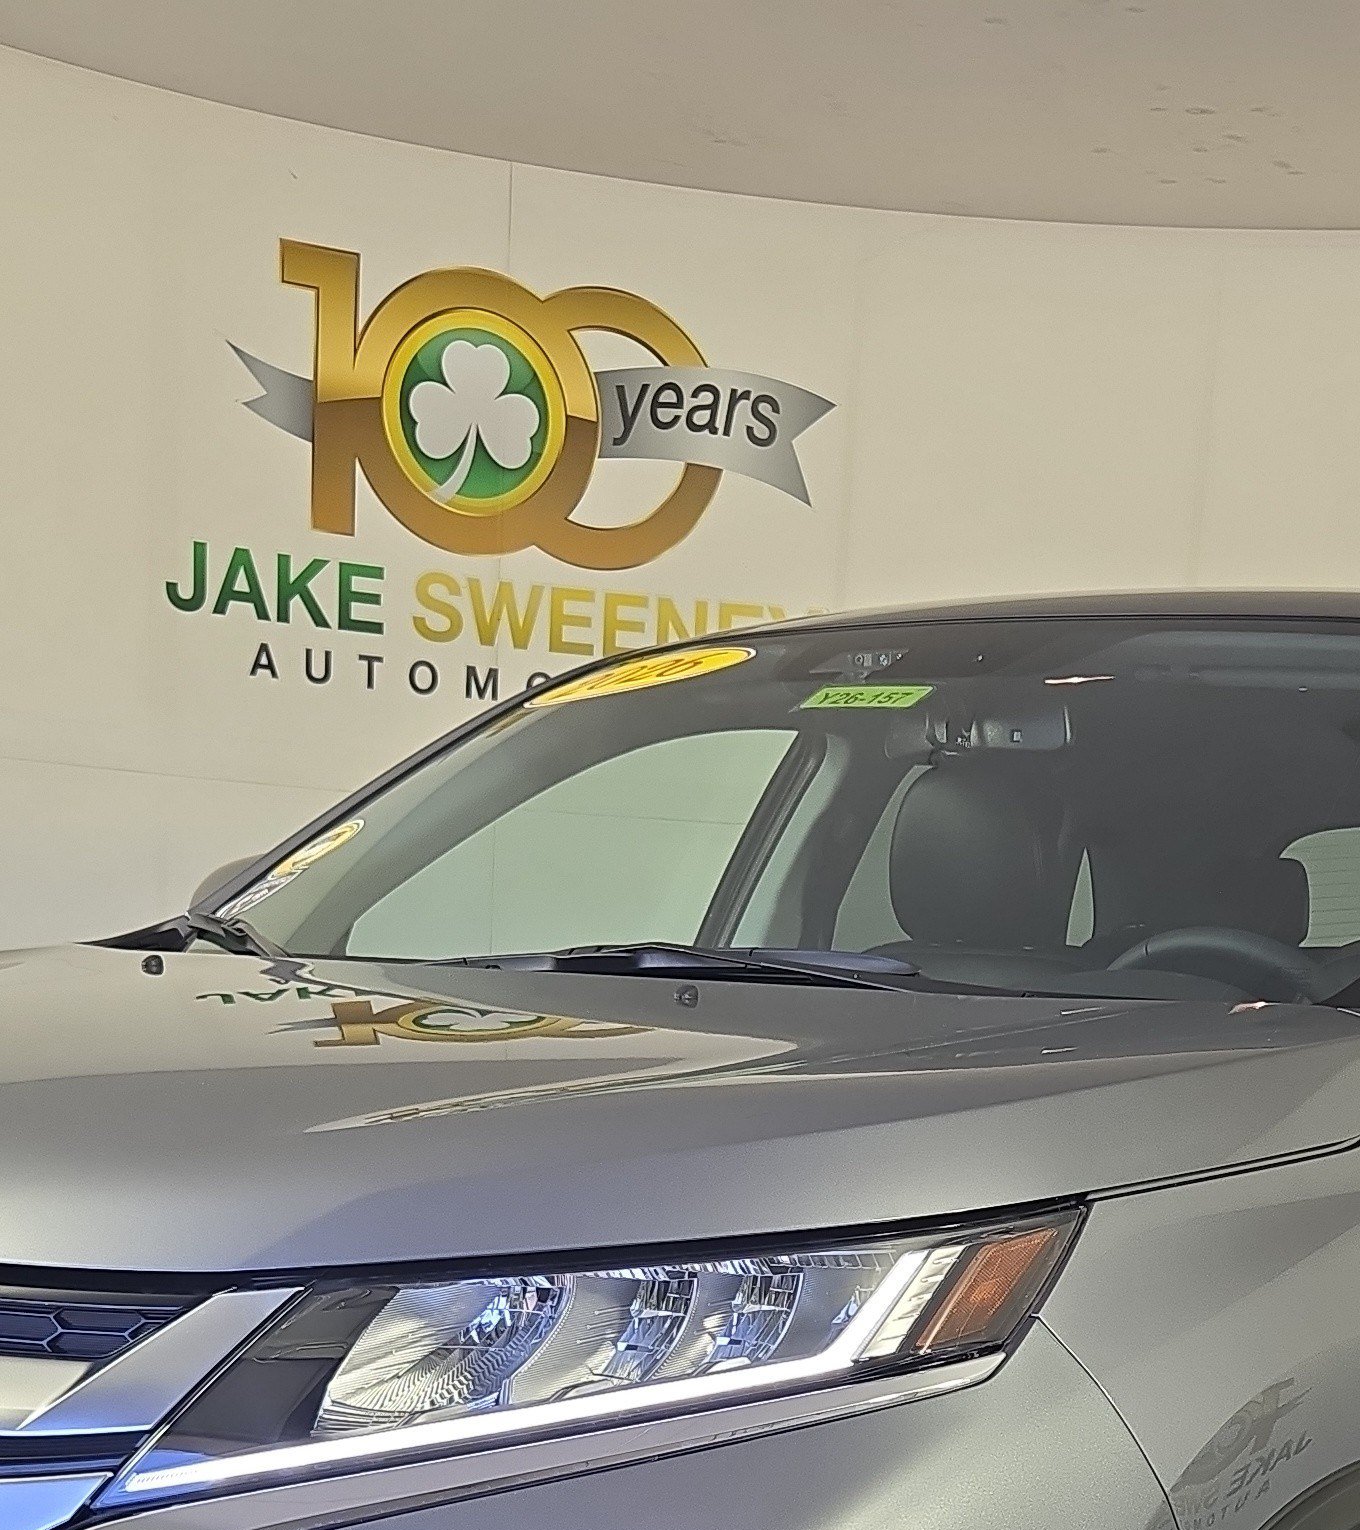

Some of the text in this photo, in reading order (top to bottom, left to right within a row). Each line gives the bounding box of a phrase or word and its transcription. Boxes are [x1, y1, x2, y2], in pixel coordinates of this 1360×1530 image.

[611, 380, 782, 448] years
[165, 540, 830, 658] JAKE SWEEN
[817, 692, 915, 705] Y26-157
